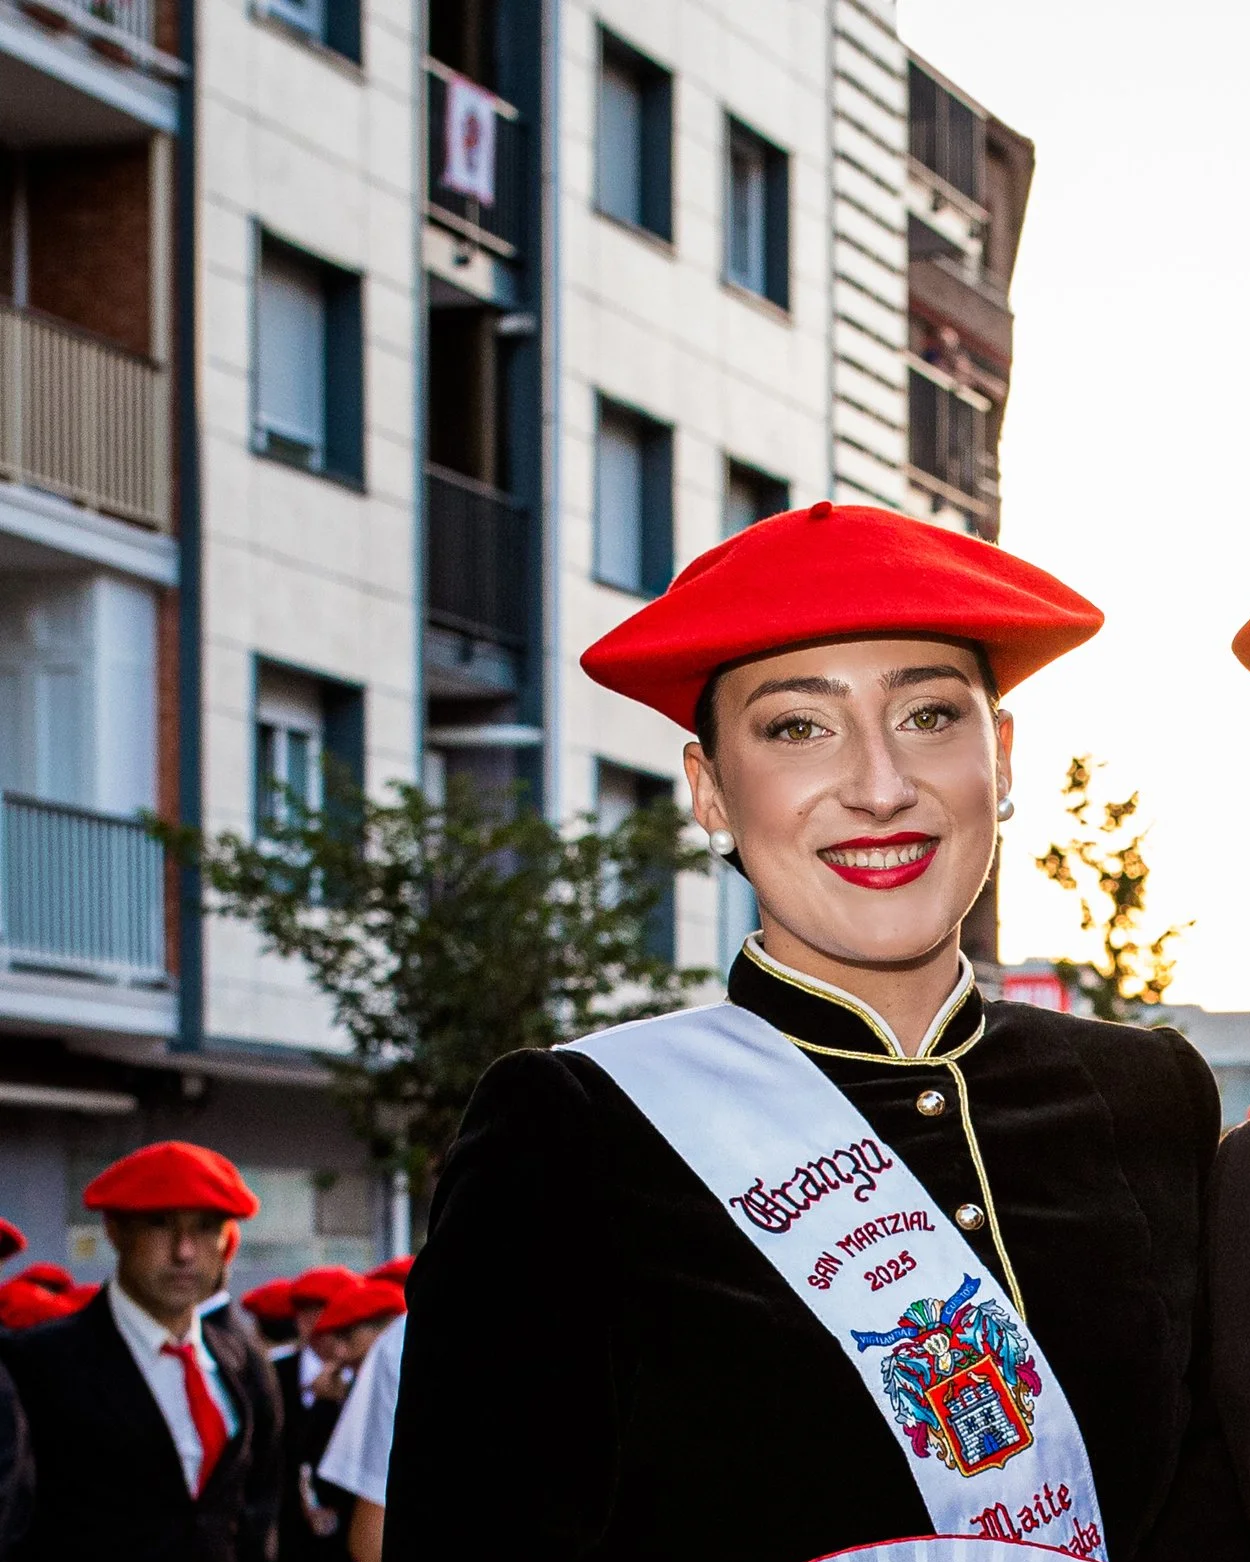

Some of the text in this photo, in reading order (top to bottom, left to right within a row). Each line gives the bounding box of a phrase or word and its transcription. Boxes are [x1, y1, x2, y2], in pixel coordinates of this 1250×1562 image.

[807, 1210, 936, 1290] SAN MARTZIAL
[863, 1249, 917, 1292] 2025
[969, 1482, 1072, 1542] Maite
